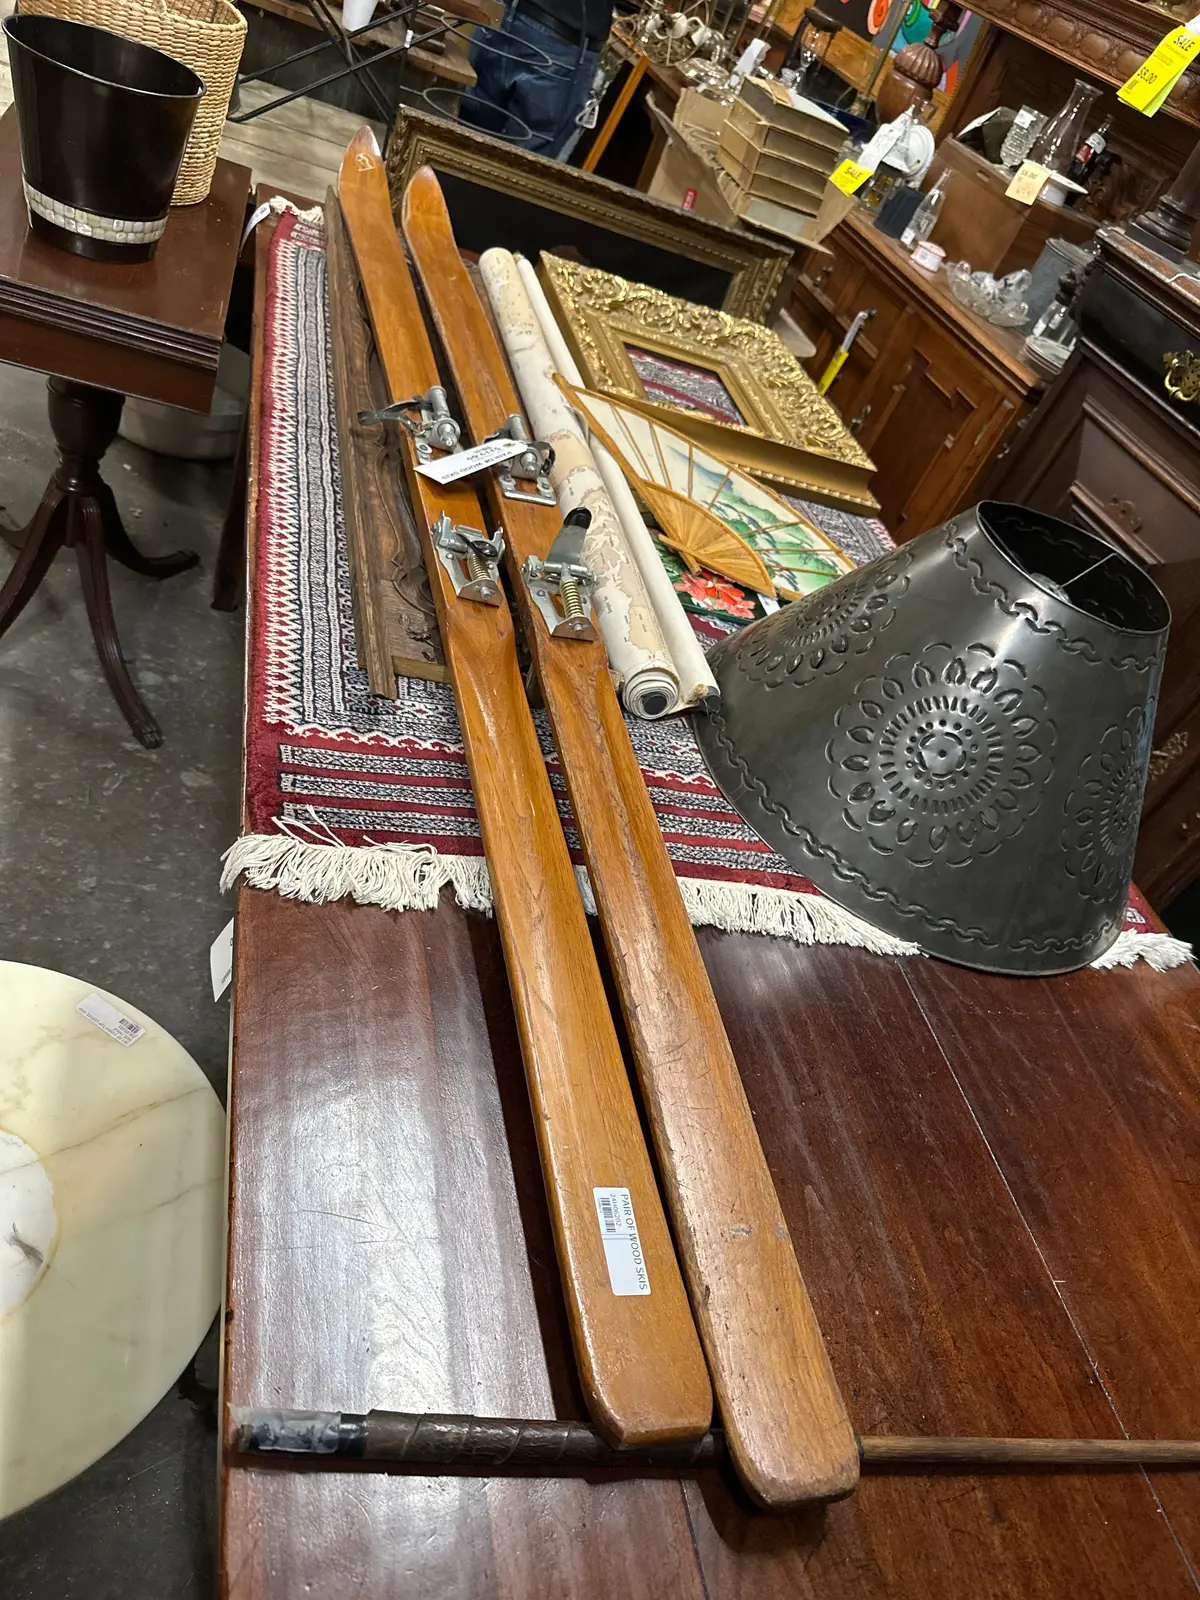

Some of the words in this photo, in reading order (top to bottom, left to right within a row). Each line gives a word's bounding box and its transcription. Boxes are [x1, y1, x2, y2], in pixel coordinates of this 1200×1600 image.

[1173, 35, 1195, 51] SALE
[1137, 67, 1157, 84] $8.00
[843, 167, 862, 180] SALE
[494, 450, 513, 460] PAIR
[459, 461, 483, 473] WOOD
[441, 471, 458, 480] SKIS
[610, 1193, 622, 1227] 24H06202
[621, 1194, 632, 1215] PAIR
[625, 1218, 636, 1231] OF
[629, 1233, 643, 1265] WOOD
[635, 1267, 648, 1290] SKIS
